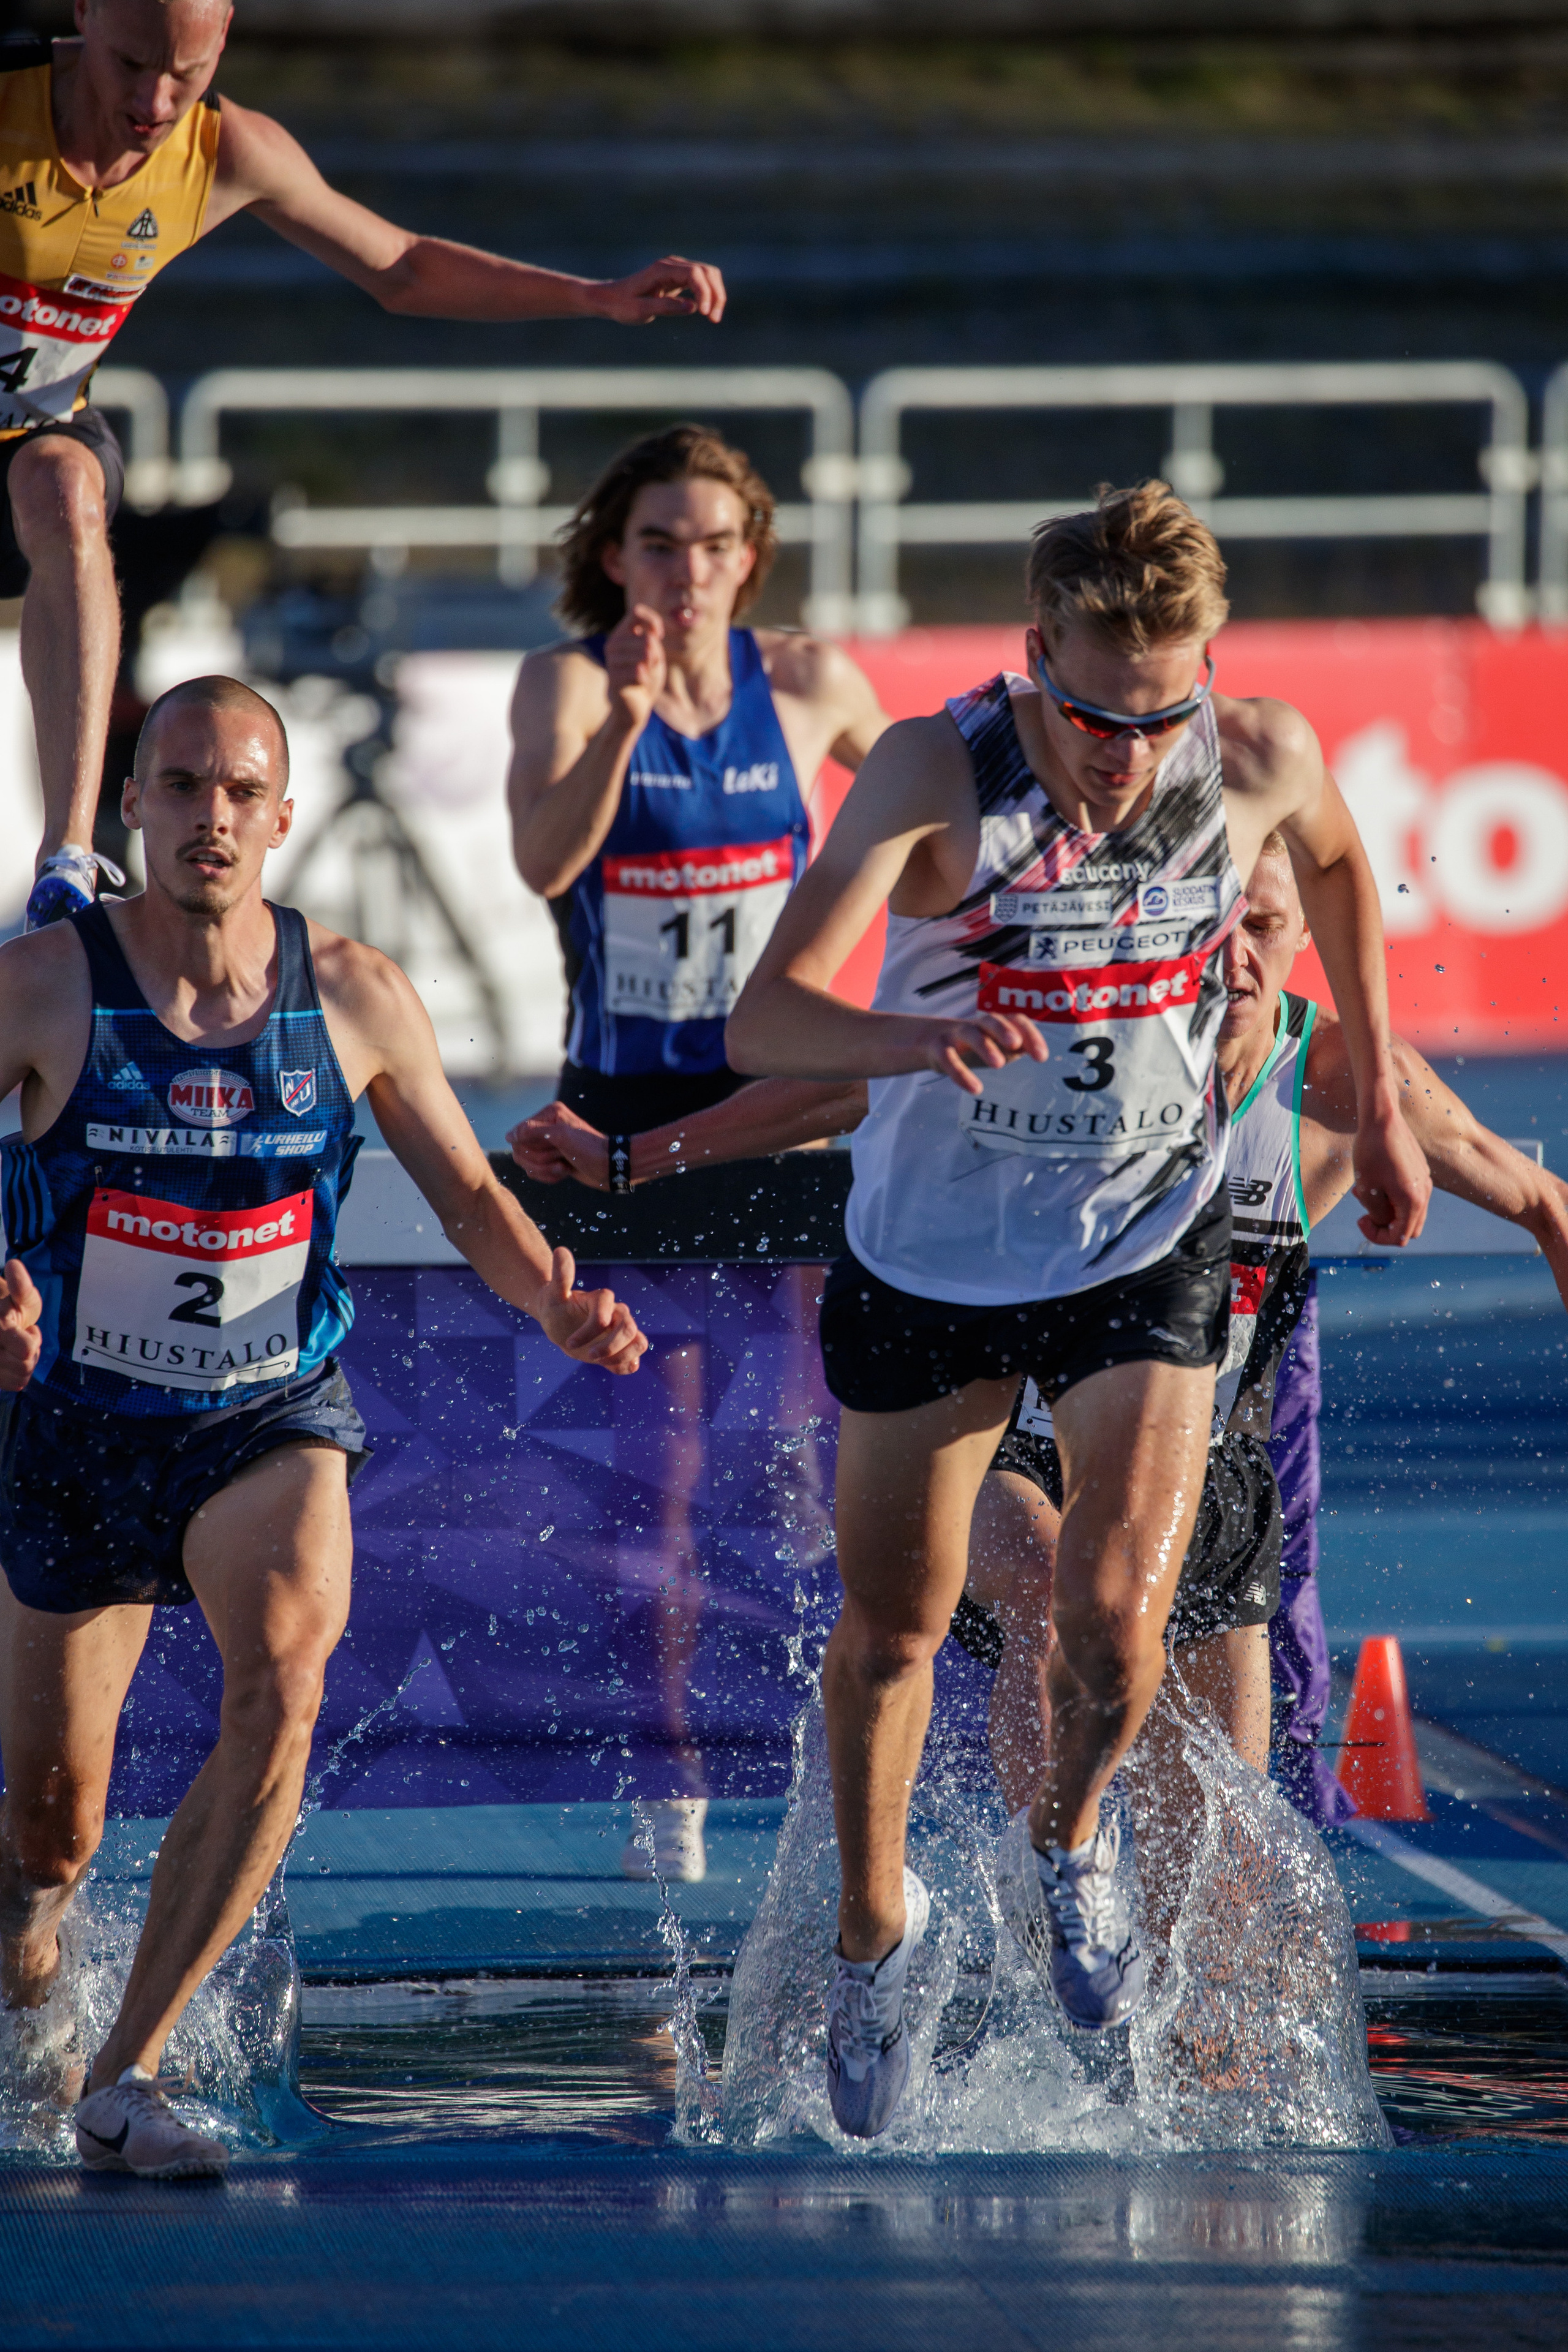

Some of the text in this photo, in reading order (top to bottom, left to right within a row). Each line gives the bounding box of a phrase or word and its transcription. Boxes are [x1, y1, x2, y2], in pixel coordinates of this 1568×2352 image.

[0, 347, 38, 393] 4
[619, 850, 777, 890] motonet
[1060, 860, 1150, 885] saucony
[661, 908, 736, 959] 11
[1064, 931, 1186, 954] PEUGEOT
[998, 970, 1189, 1012] motonet
[1063, 1037, 1115, 1091] 3
[108, 1080, 151, 1090] adidas
[170, 1084, 254, 1109] MIIKA
[190, 1108, 229, 1118] TEAM
[973, 1100, 1183, 1137] HIUSTALO
[109, 1127, 215, 1147] NIVALA
[264, 1133, 325, 1145] URHEILU
[274, 1144, 314, 1156] SHOP
[107, 1209, 295, 1250] motonet
[167, 1272, 225, 1329] 2
[86, 1325, 288, 1370] HIUSTALO
